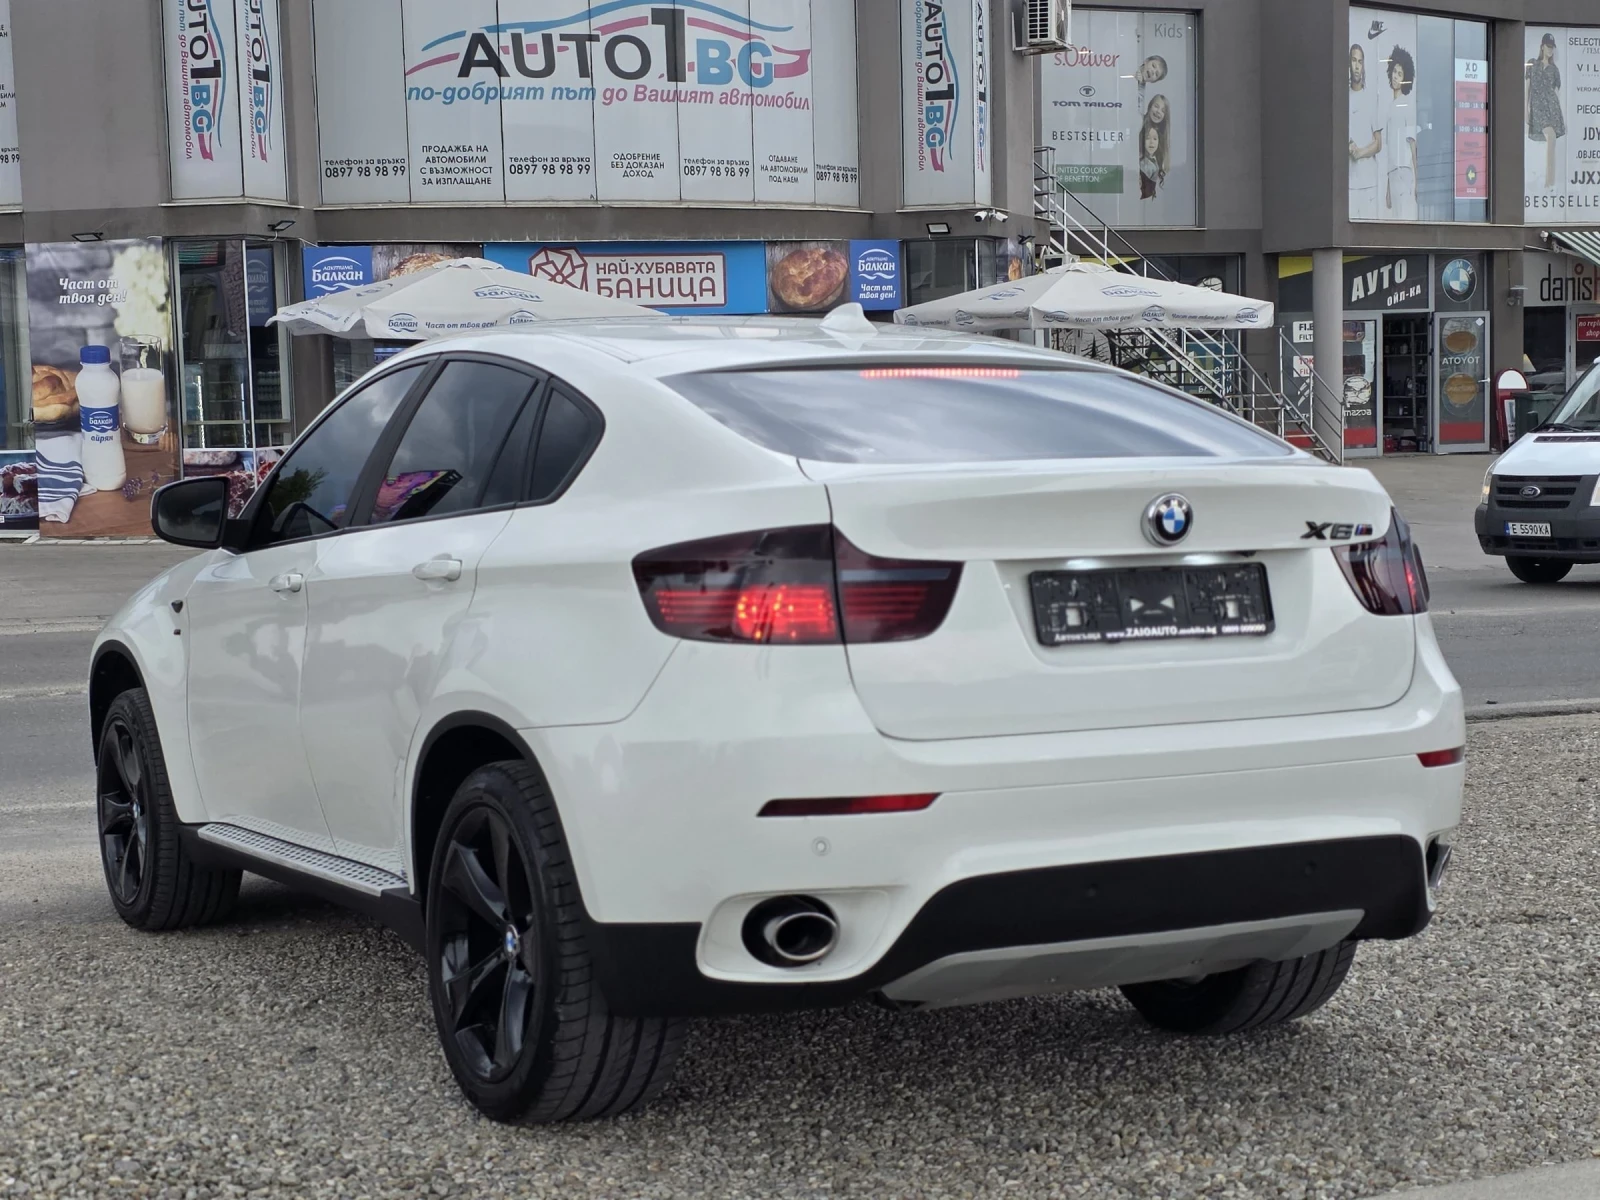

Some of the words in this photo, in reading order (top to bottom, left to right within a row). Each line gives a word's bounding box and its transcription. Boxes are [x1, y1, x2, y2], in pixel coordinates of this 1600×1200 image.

[1154, 23, 1183, 39] Kids
[180, 50, 190, 96] Вашият
[406, 81, 545, 105] по-добрият
[550, 86, 597, 101] път
[601, 86, 628, 106] до
[633, 84, 714, 105] Вашият
[718, 88, 810, 111] автомобил
[916, 76, 925, 116] Вашият
[183, 98, 194, 160] автомобил
[1052, 130, 1124, 142] BESTSELLER
[421, 145, 474, 154] ПРОДАЖБА
[476, 144, 489, 153] НА
[918, 117, 927, 171] автомобил
[324, 158, 364, 167] телефон
[376, 157, 406, 166] връзка
[425, 155, 487, 164] АВТОМОБИЛИ
[509, 155, 548, 164] телефон
[561, 156, 591, 164] връзка
[612, 153, 661, 161] ОДОБРЕНИЕ
[768, 154, 798, 164] ОТДАВАНЕ
[610, 161, 624, 169] БЕЗ
[625, 161, 665, 170] ДОКАЗАН
[683, 158, 716, 166] телефон
[726, 159, 750, 167] връзка
[325, 167, 353, 178] 0897
[357, 166, 371, 178] 98
[375, 166, 389, 177] 98
[392, 165, 406, 177] 99
[429, 166, 493, 175] ВЪЗМОЖНОСТ
[509, 164, 538, 175] 0897
[541, 164, 556, 175] 98
[559, 164, 574, 175] 98
[577, 163, 591, 175] 99
[622, 169, 655, 178] ДОХОД
[683, 165, 707, 176] 0897
[710, 166, 722, 177] 98
[724, 166, 736, 177] 98
[739, 167, 750, 178] 99
[769, 165, 809, 174] АВТОМОБИЛИ
[1080, 166, 1108, 174] COLORS
[421, 177, 434, 186] ЗА
[435, 177, 492, 186] ИЗПЛАЩАНЕ
[768, 175, 782, 184] ПОД
[783, 176, 799, 184] НАЕМ
[816, 171, 831, 182] 0897
[832, 172, 841, 183] 98
[841, 173, 849, 183] 98
[849, 173, 858, 183] 99
[596, 258, 716, 275] НАЙ-ХУБАВАТА
[858, 259, 895, 272] Балкан
[312, 268, 364, 282] Балкан
[59, 277, 95, 290] Част
[97, 279, 119, 289] от
[860, 283, 881, 292] Част
[596, 276, 716, 302] БАНИЦА
[58, 292, 95, 304] твоя
[97, 289, 128, 306] ден!
[473, 290, 541, 300] Балкан
[859, 291, 879, 299] твоя
[879, 290, 896, 301] ден!
[1386, 284, 1422, 307] ОЙЛ-КА
[388, 319, 418, 328] Балкан
[425, 321, 445, 329] Част
[459, 320, 481, 329] твоя
[481, 319, 498, 329] ден!
[89, 417, 113, 425] Балкан
[90, 434, 114, 444] айрян
